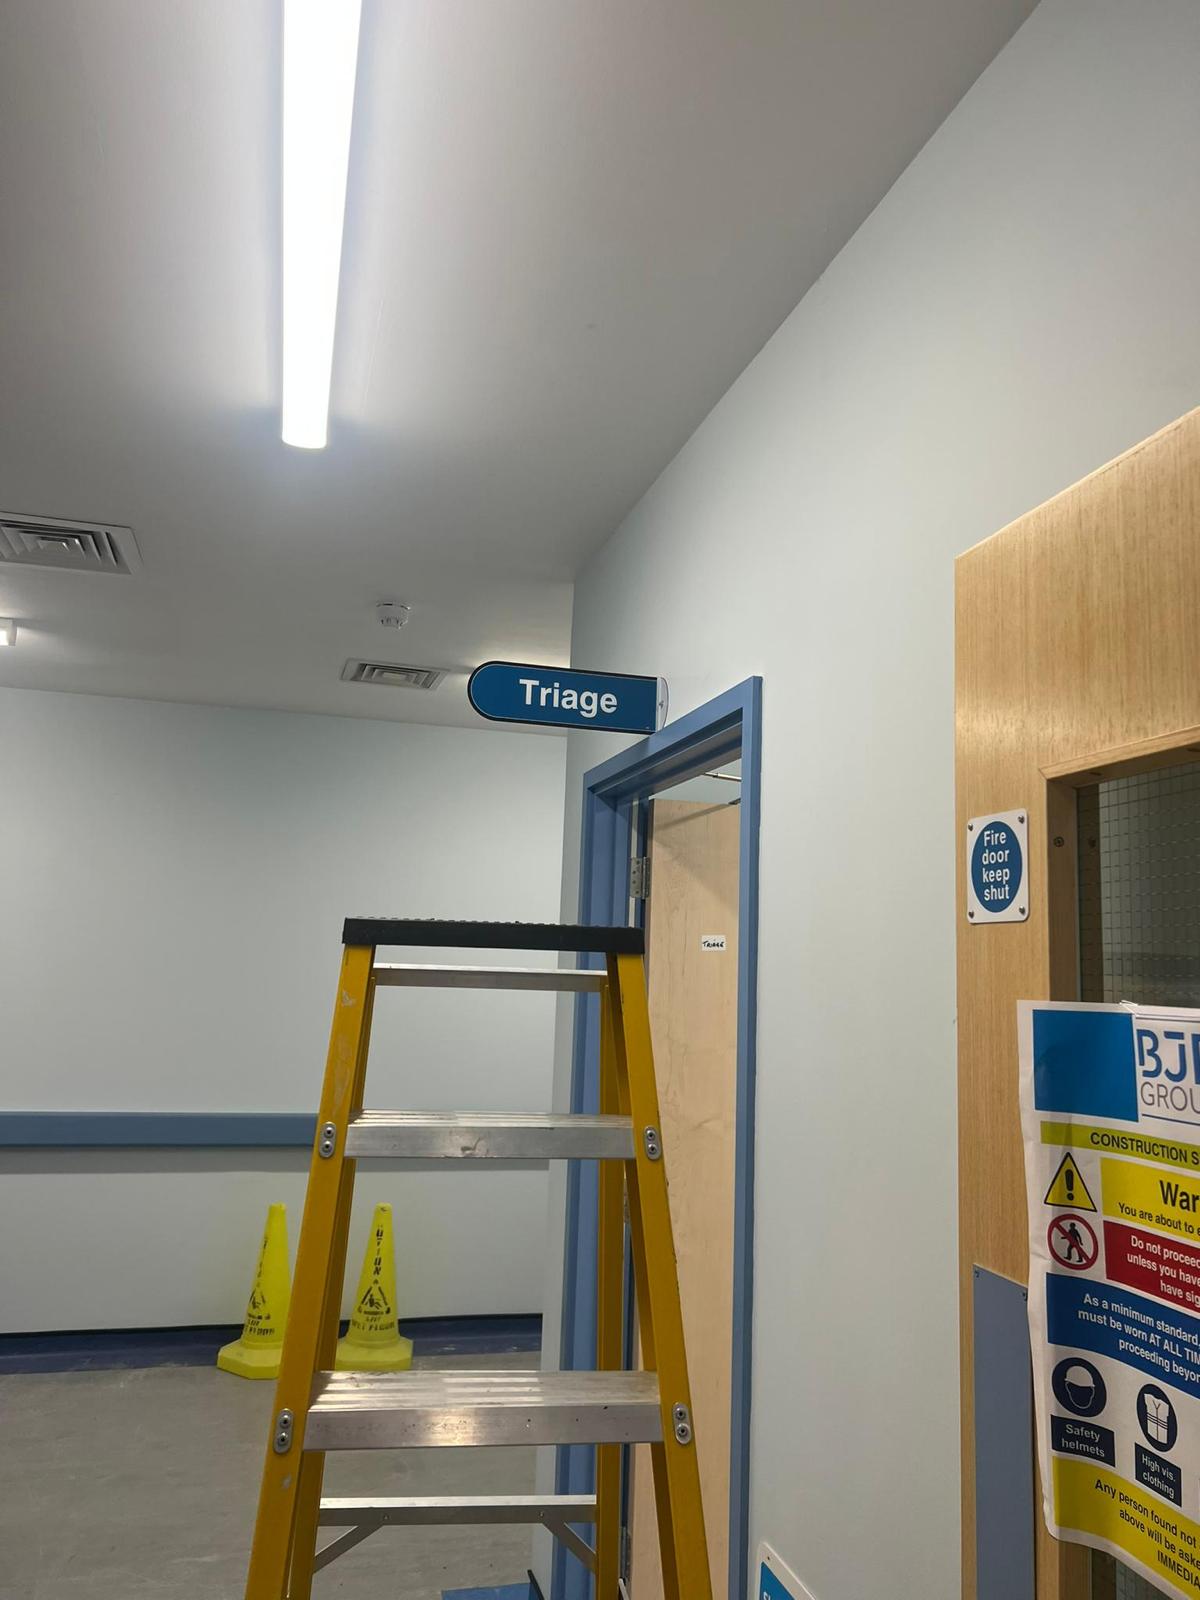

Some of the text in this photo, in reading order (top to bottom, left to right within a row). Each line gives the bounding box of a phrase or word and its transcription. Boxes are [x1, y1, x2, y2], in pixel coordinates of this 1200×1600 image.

[519, 679, 618, 718] Triage
[983, 830, 1007, 847] Fire
[982, 849, 1010, 865] door
[982, 867, 1010, 884] keep
[984, 884, 1010, 901] shut
[1090, 1132, 1187, 1163] CONSTRUCTION
[1159, 1180, 1200, 1213] War
[1118, 1202, 1137, 1217] You
[1139, 1209, 1153, 1222] are
[1155, 1213, 1182, 1231] about
[1184, 1221, 1194, 1234] to
[1130, 1235, 1144, 1249] Do
[1146, 1241, 1161, 1256] not
[1127, 1253, 1157, 1272] unless
[1159, 1264, 1177, 1277] you
[1160, 1280, 1183, 1299] have
[1083, 1293, 1099, 1307] As
[1101, 1300, 1109, 1310] a
[1111, 1302, 1155, 1327] minimum
[1078, 1310, 1107, 1326] must
[1109, 1316, 1122, 1331] be
[1124, 1323, 1148, 1341] worn
[1149, 1333, 1161, 1347] AT
[1163, 1339, 1183, 1358] ALL
[1119, 1339, 1170, 1373] proceeding
[1061, 1438, 1105, 1457] helmets
[1065, 1424, 1101, 1443] Safety
[1141, 1453, 1176, 1482] High vis.
[1142, 1471, 1175, 1500] clothing
[1094, 1479, 1197, 1549] Any person found not
[1119, 1508, 1145, 1533] above
[1147, 1527, 1163, 1545] will
[1164, 1536, 1176, 1554] be
[1157, 1550, 1200, 1590] IMMEDIA
